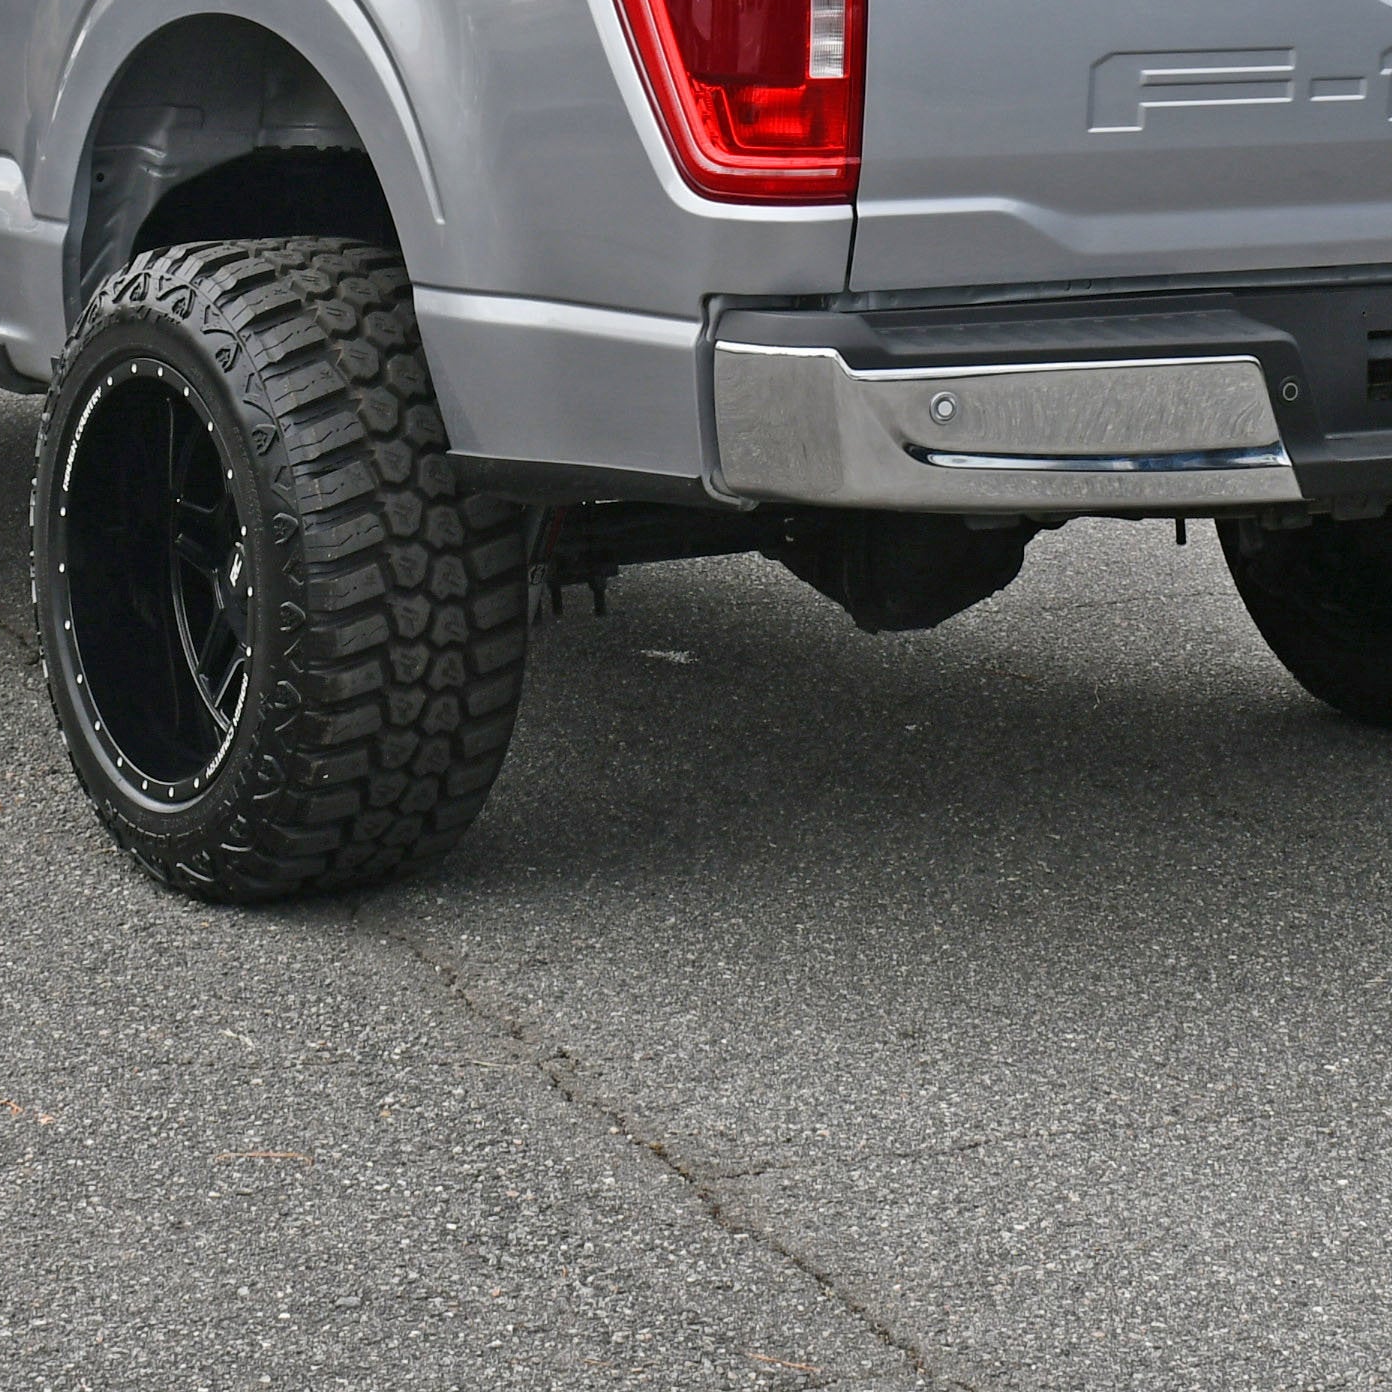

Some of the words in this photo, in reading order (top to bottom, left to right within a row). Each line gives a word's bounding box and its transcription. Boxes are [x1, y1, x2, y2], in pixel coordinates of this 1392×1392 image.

[63, 440, 78, 492] ROUGH
[75, 385, 102, 441] COUNTRY
[205, 725, 234, 779] COUNTRY
